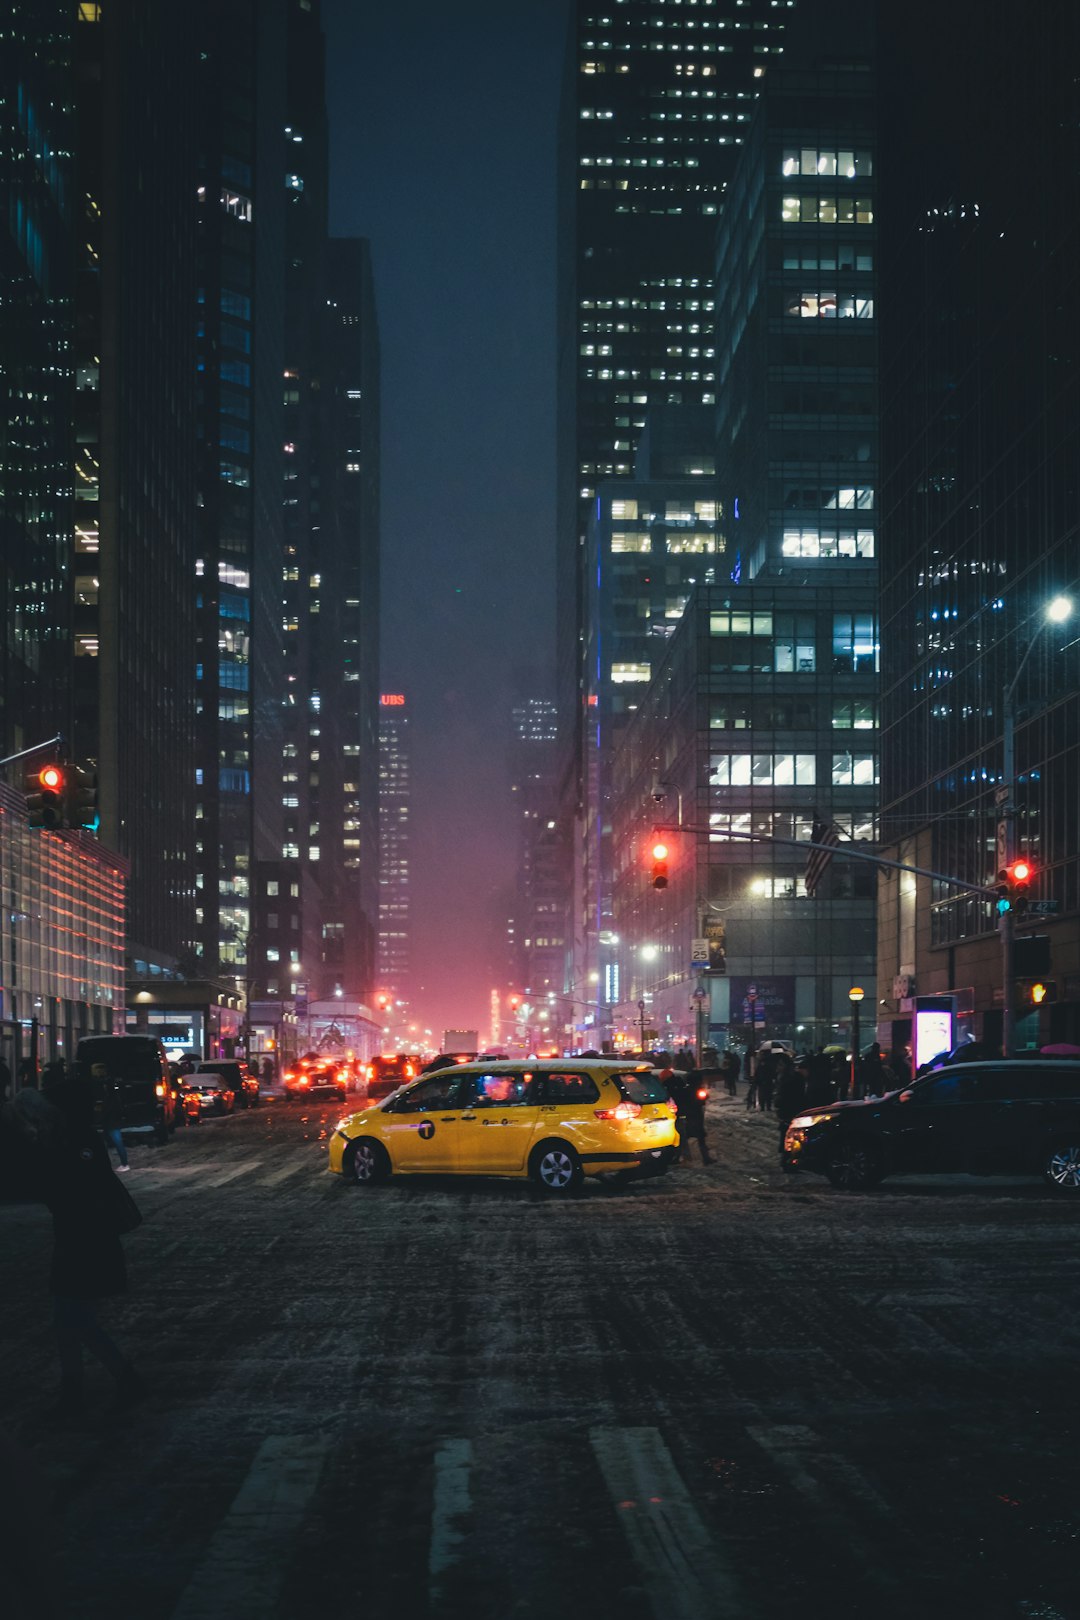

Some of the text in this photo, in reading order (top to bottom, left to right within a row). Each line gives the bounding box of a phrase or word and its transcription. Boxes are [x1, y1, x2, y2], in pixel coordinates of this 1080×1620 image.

[381, 695, 405, 705] UBS
[1035, 902, 1049, 913] 42
[693, 951, 708, 959] 25
